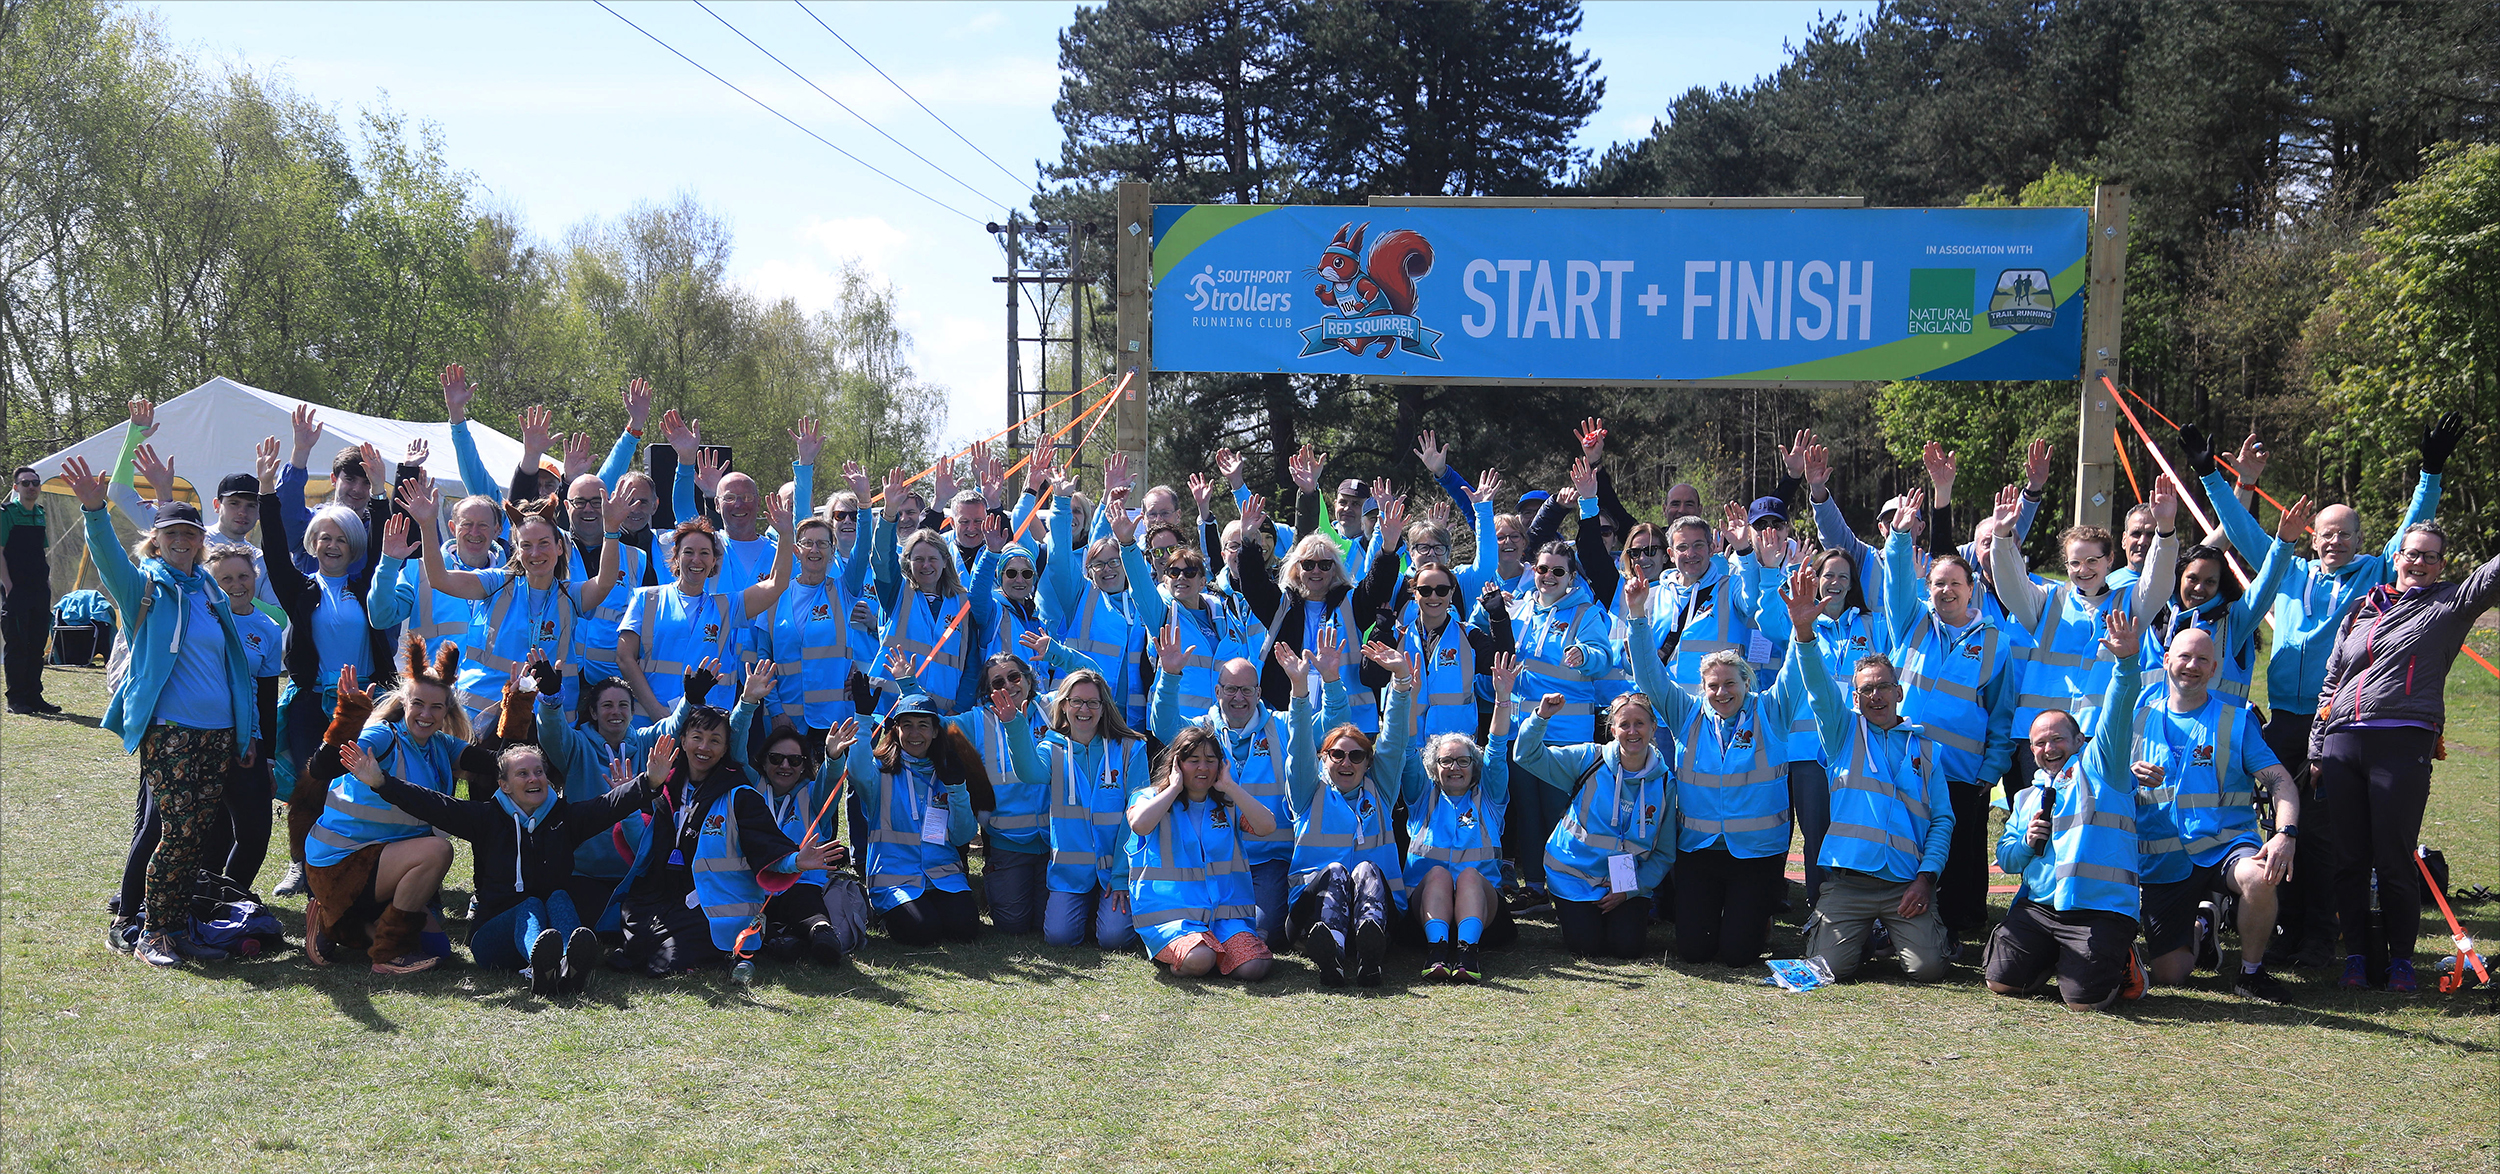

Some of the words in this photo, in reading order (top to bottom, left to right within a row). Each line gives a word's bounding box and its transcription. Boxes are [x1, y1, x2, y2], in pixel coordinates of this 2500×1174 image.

[1926, 245, 1937, 254] IN
[1939, 245, 2004, 254] ASSOCIATION
[2006, 245, 2033, 254] WITH
[1217, 269, 1292, 284] SOUTHPORT
[1461, 258, 1634, 339] START
[1638, 284, 1667, 316] +
[1682, 259, 1874, 341] FINISH
[1341, 300, 1355, 312] 10K
[1909, 308, 1971, 321] NATURAL
[1991, 310, 2014, 319] TRAIL
[2016, 310, 2052, 319] RUNNING
[1992, 316, 2051, 325] ASSOCIATION
[1192, 316, 1253, 328] RUNNING
[1260, 317, 1292, 328] CLUB
[1328, 321, 1352, 335] RED
[1354, 317, 1414, 335] SQUIRREL
[1908, 321, 1972, 334] ENGLAND
[1396, 329, 1414, 338] 10K
